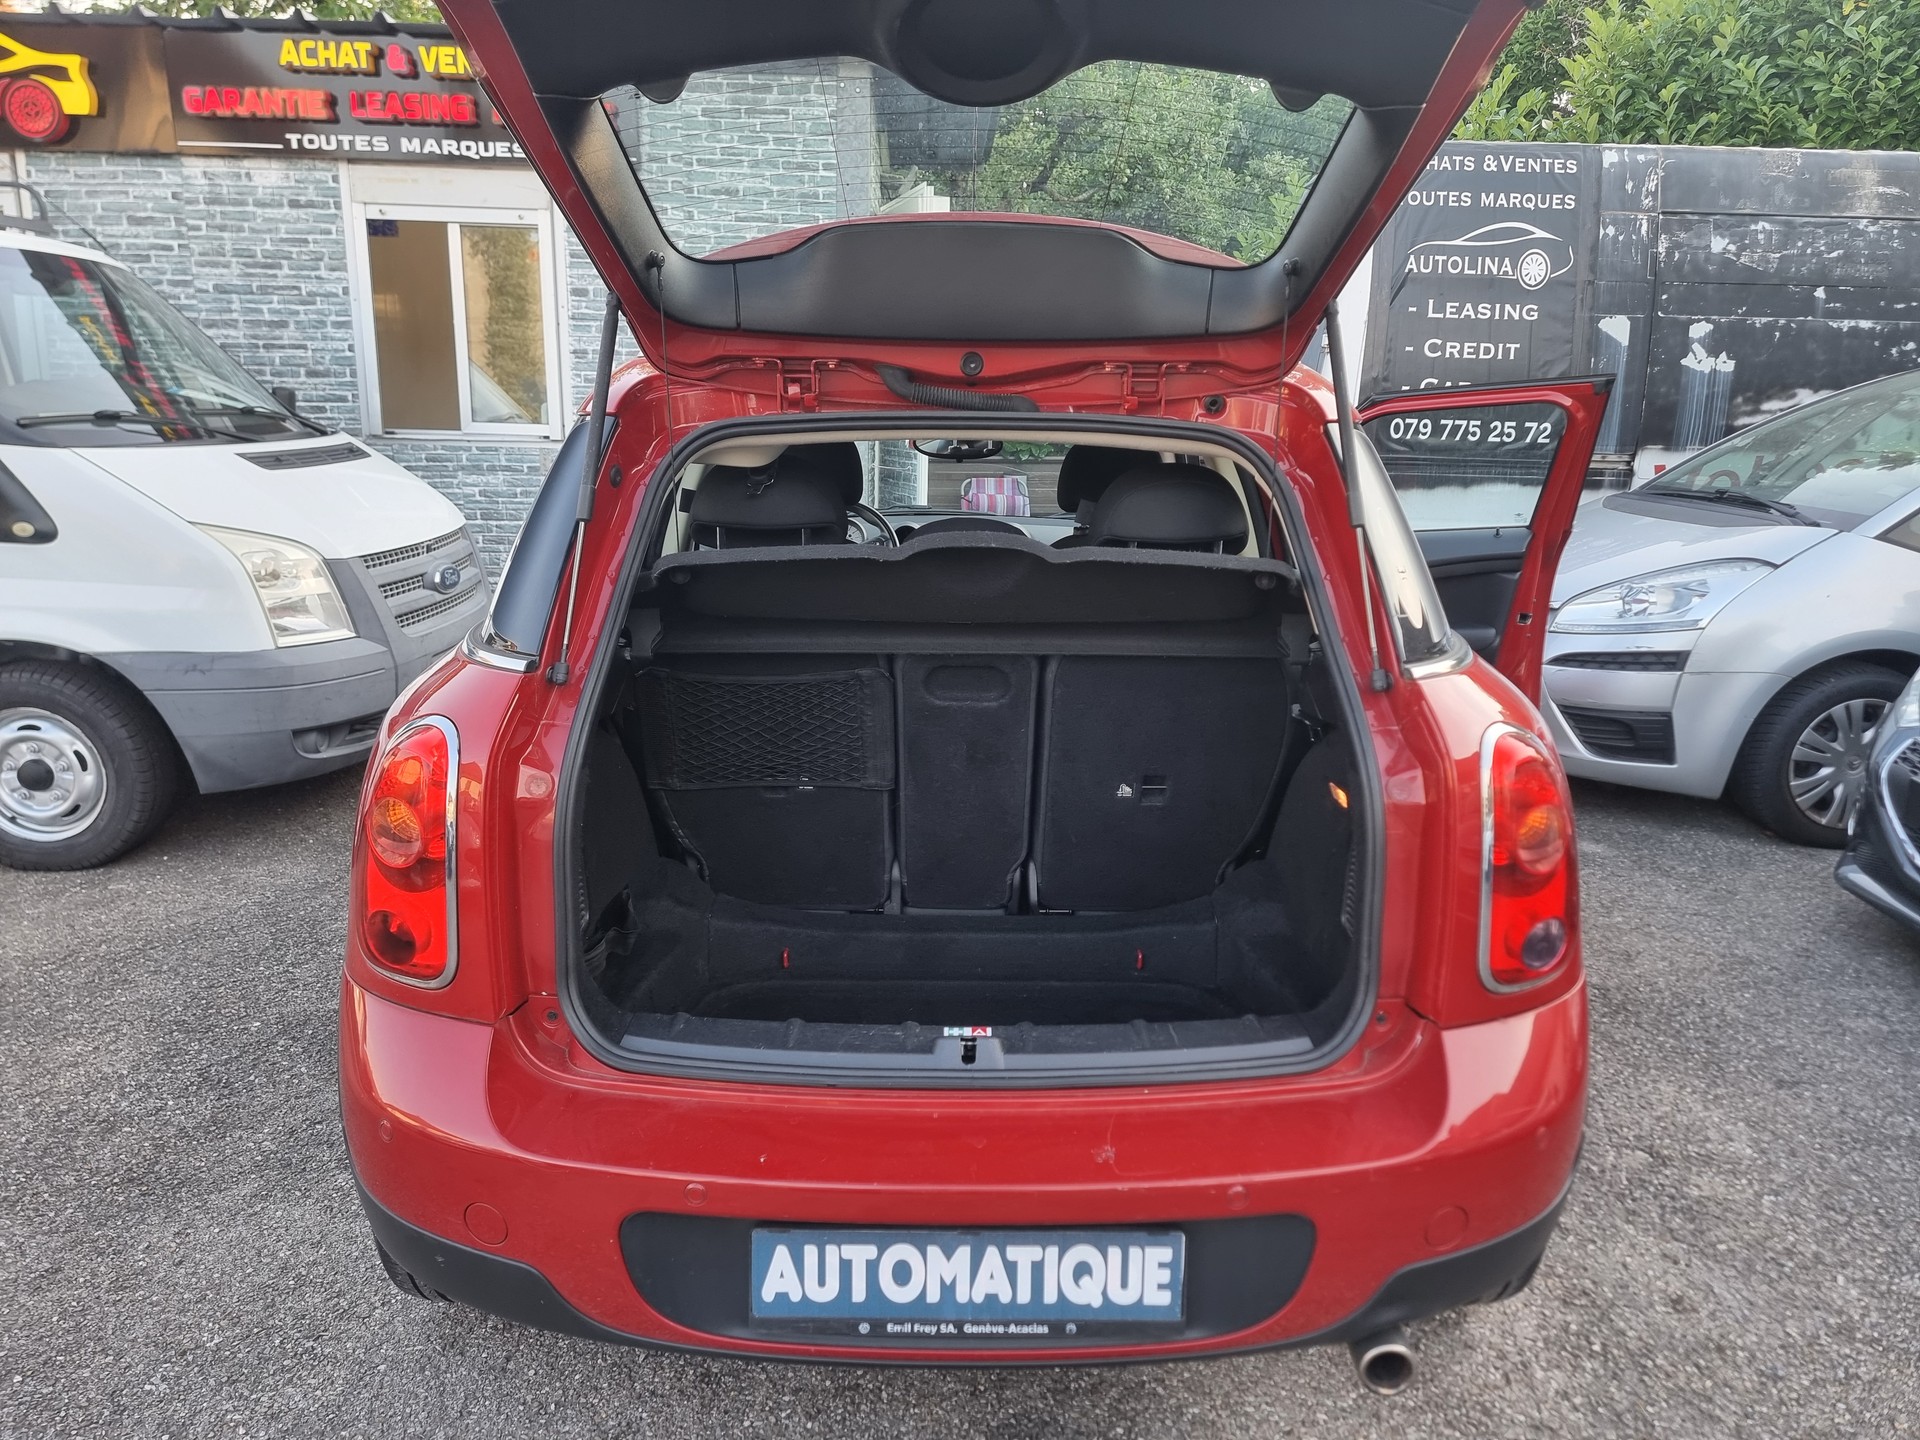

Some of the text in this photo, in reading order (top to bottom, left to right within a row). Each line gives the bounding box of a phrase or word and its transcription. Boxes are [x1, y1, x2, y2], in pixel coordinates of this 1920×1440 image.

[279, 39, 473, 75] ACHAT & VEN
[183, 86, 329, 120] GARANTIE
[350, 90, 472, 123] LEASING
[285, 133, 525, 159] TOUTES MARQUES
[1426, 155, 1475, 171] HATS
[1401, 190, 1576, 210] OUTES MARQUES
[1405, 254, 1513, 276] AUTOLINA
[1427, 299, 1539, 321] LEASING
[1423, 338, 1520, 360] CREDIT
[1389, 418, 1552, 443] 079 775 25 72
[761, 1243, 1174, 1309] AUTOMATIQUE
[886, 1322, 912, 1333] Emil
[913, 1322, 937, 1335] Frey
